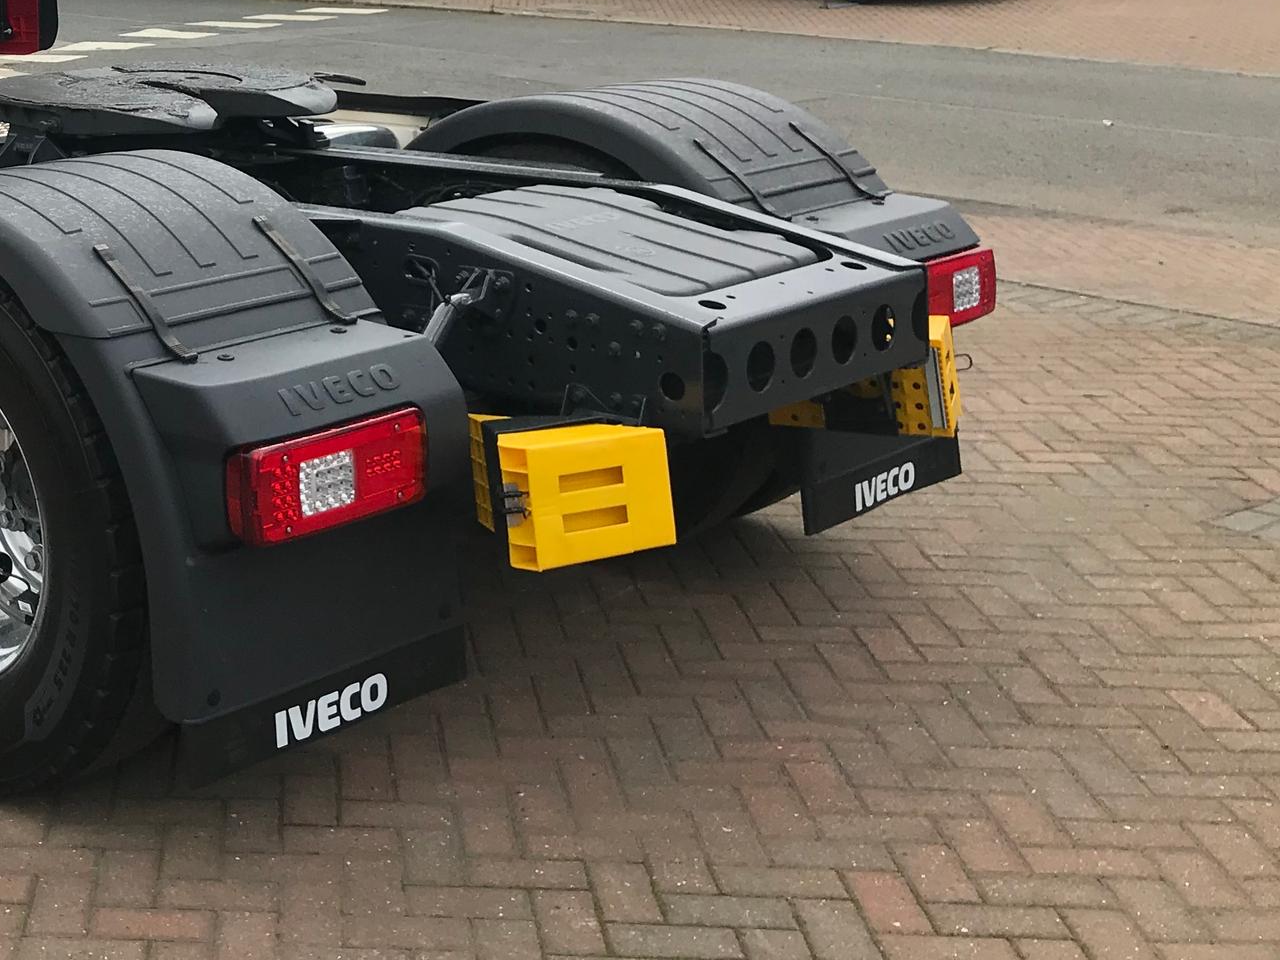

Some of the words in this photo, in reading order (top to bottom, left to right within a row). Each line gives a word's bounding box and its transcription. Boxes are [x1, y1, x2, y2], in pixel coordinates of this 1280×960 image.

[883, 222, 955, 253] IVECO
[277, 363, 400, 417] IVECO
[854, 461, 916, 513] IVECO
[275, 672, 388, 748] IVECO
